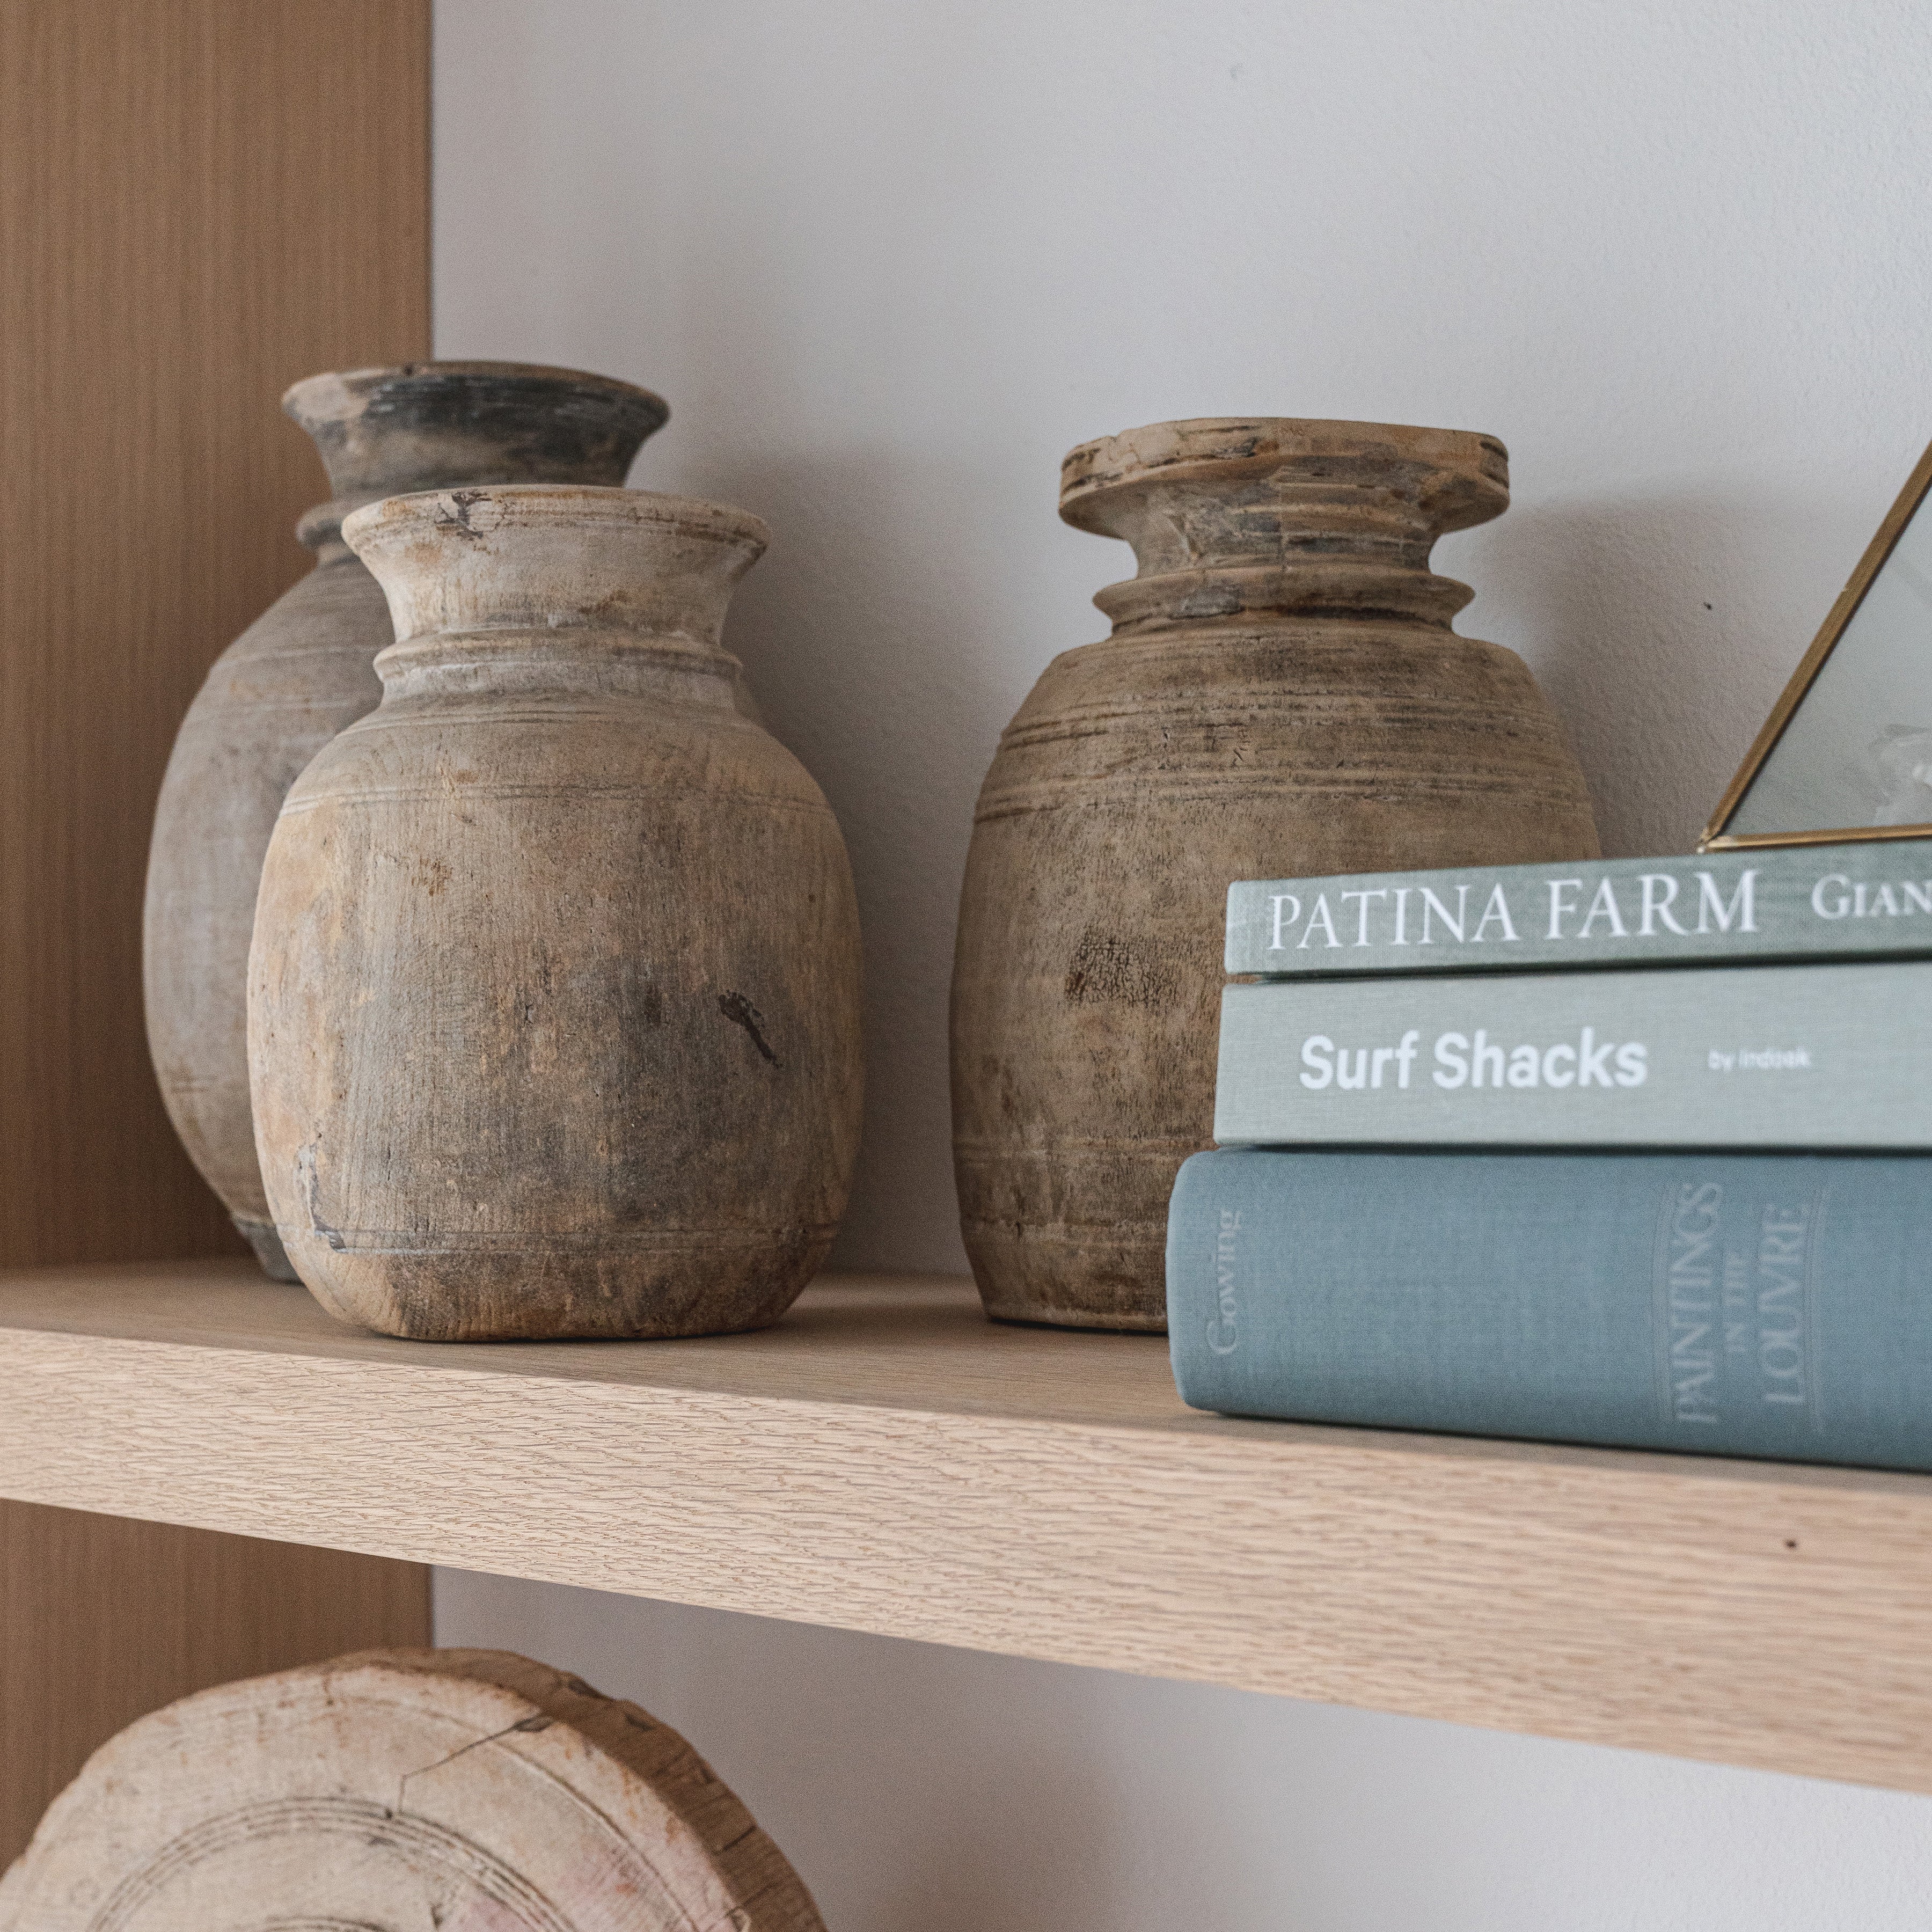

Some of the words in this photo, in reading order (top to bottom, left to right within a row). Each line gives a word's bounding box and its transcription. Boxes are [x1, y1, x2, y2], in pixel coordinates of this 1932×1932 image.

[1267, 882, 1520, 950] PATINA
[1545, 869, 1762, 940] FARM
[1299, 1029, 1419, 1089] Surf
[1432, 1026, 1648, 1088] Shacks
[1708, 1048, 1736, 1073] by
[1669, 1182, 1723, 1424] PAINTINGS
[1724, 1248, 1748, 1306] THE
[1758, 1203, 1809, 1404] LOUVRE
[1724, 1322, 1747, 1353] IN
